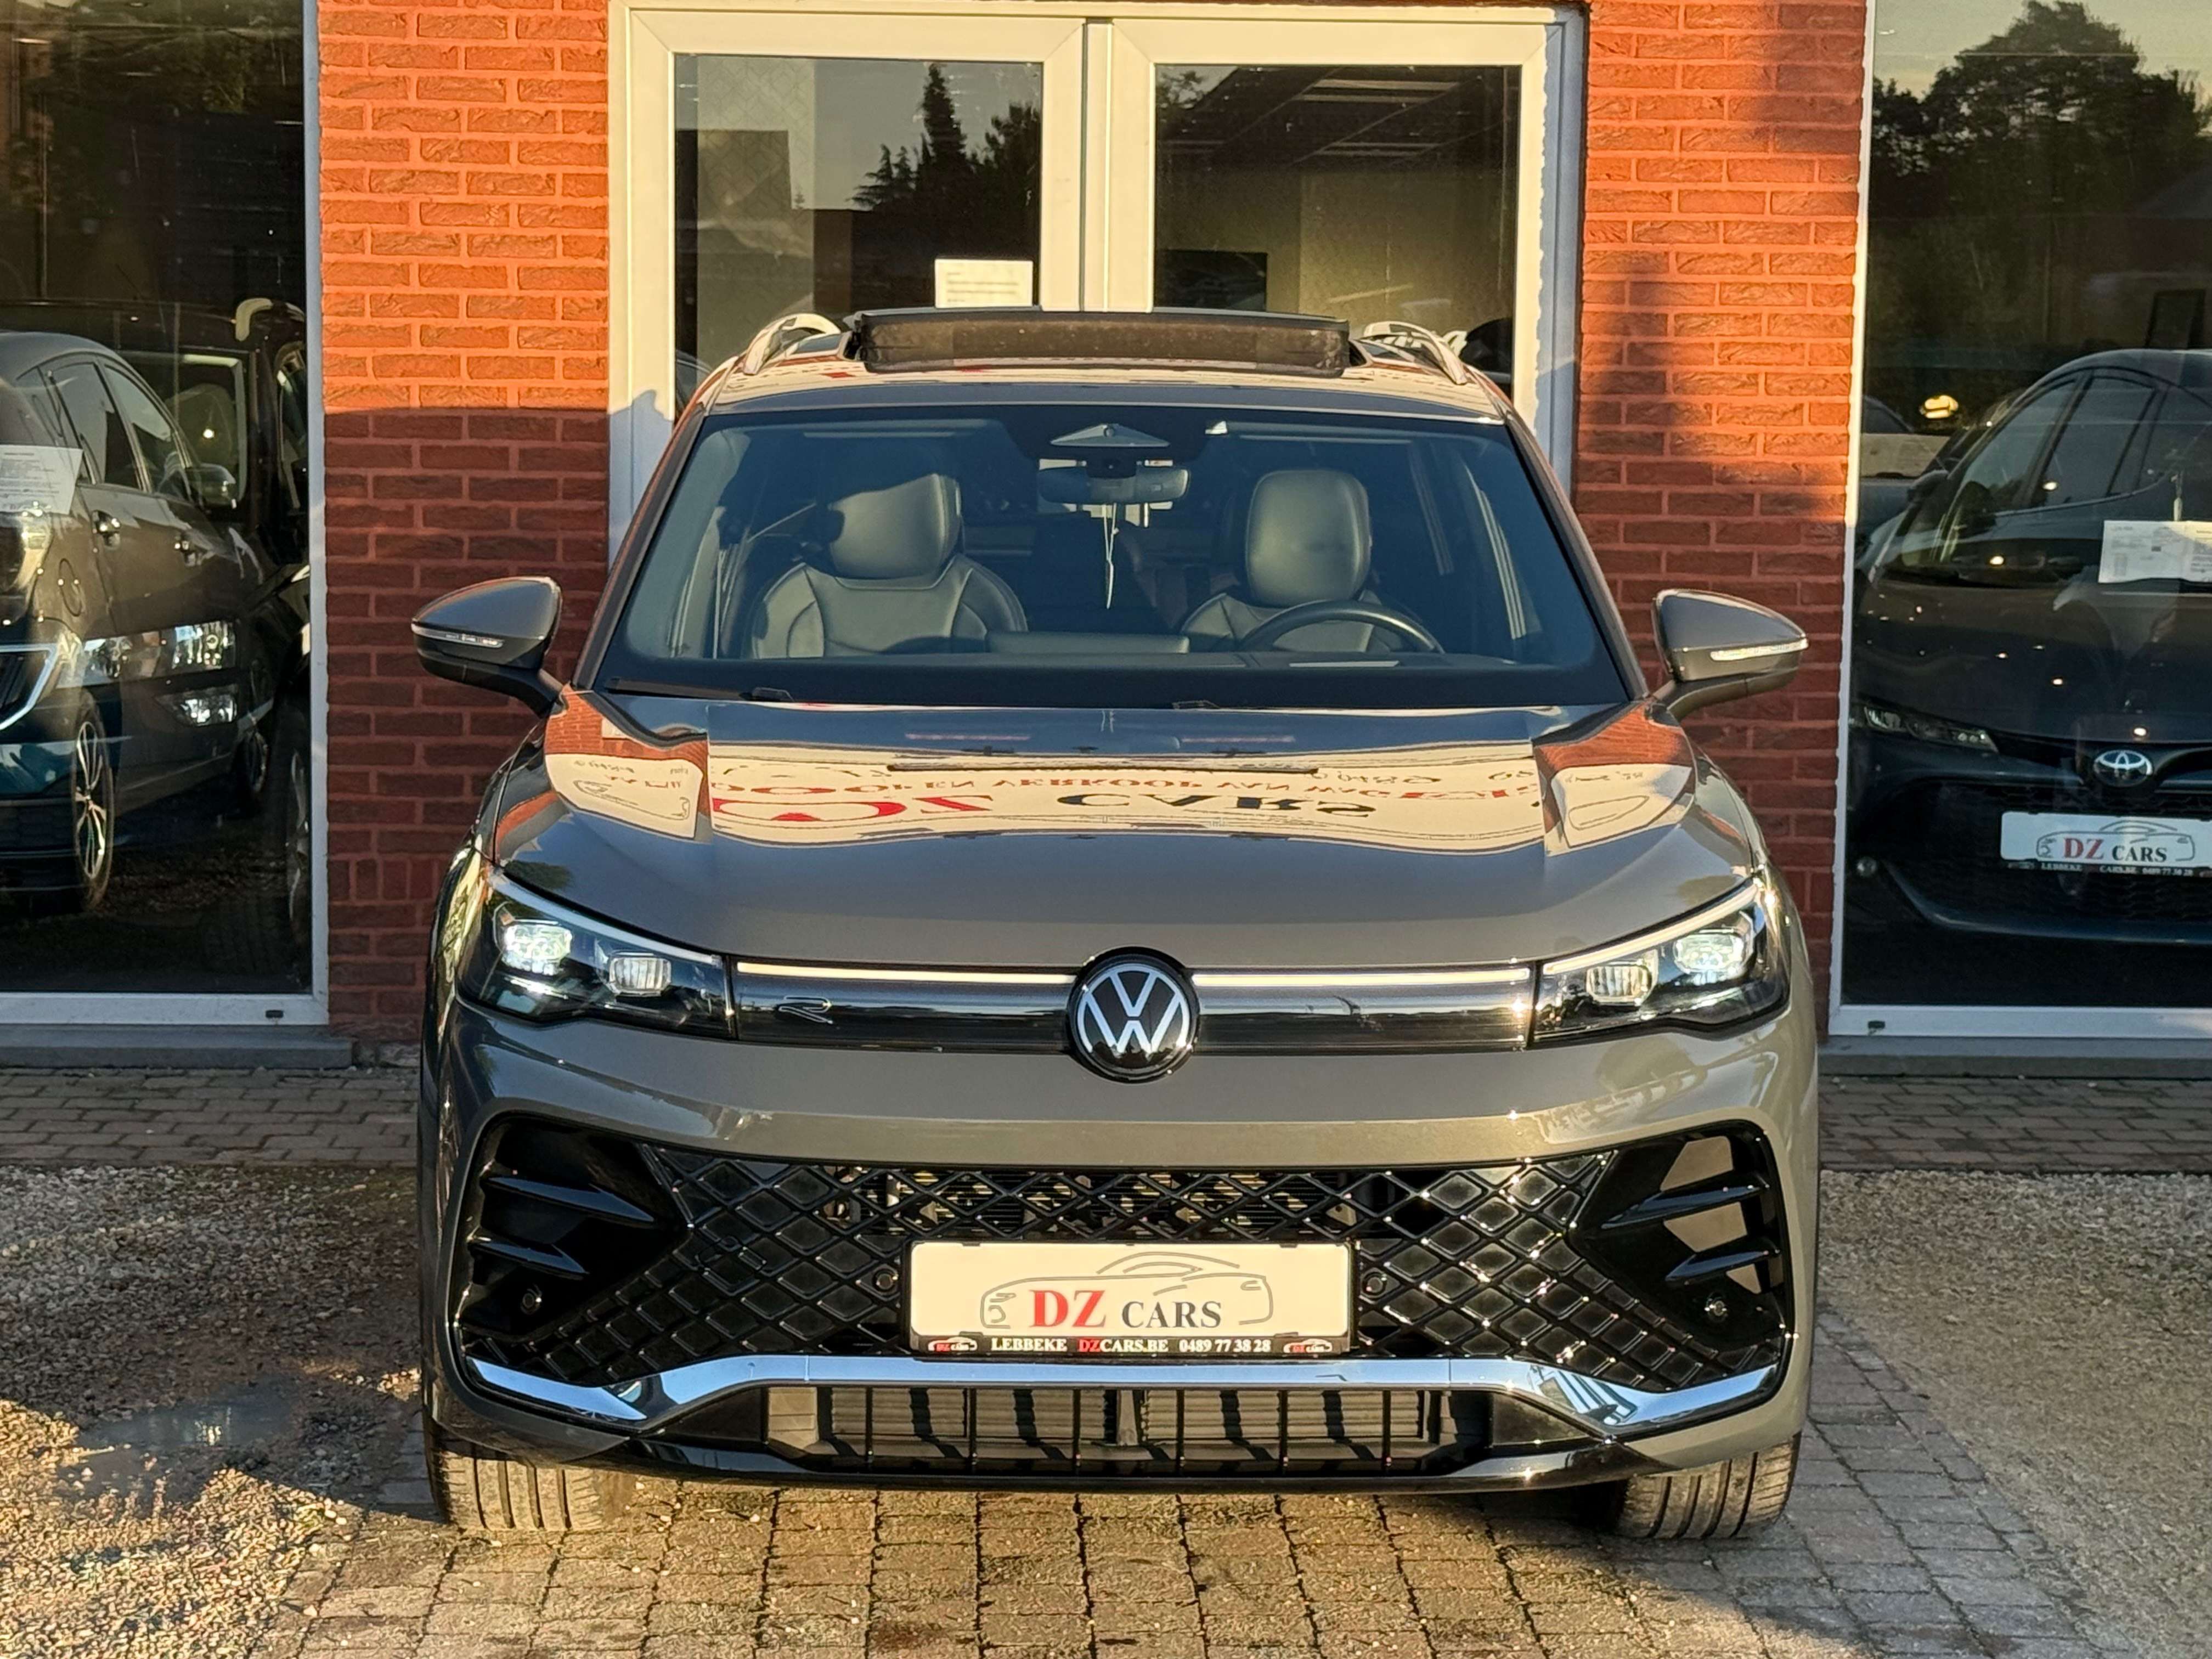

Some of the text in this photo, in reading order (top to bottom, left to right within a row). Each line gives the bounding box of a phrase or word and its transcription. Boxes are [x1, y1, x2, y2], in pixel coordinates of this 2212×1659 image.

[2064, 837, 2168, 862] DZ CARS
[1029, 1289, 1222, 1329] DZ CARS
[991, 1338, 1272, 1352] LEBBEKE DZCARS.BE 0489 77 38 28
